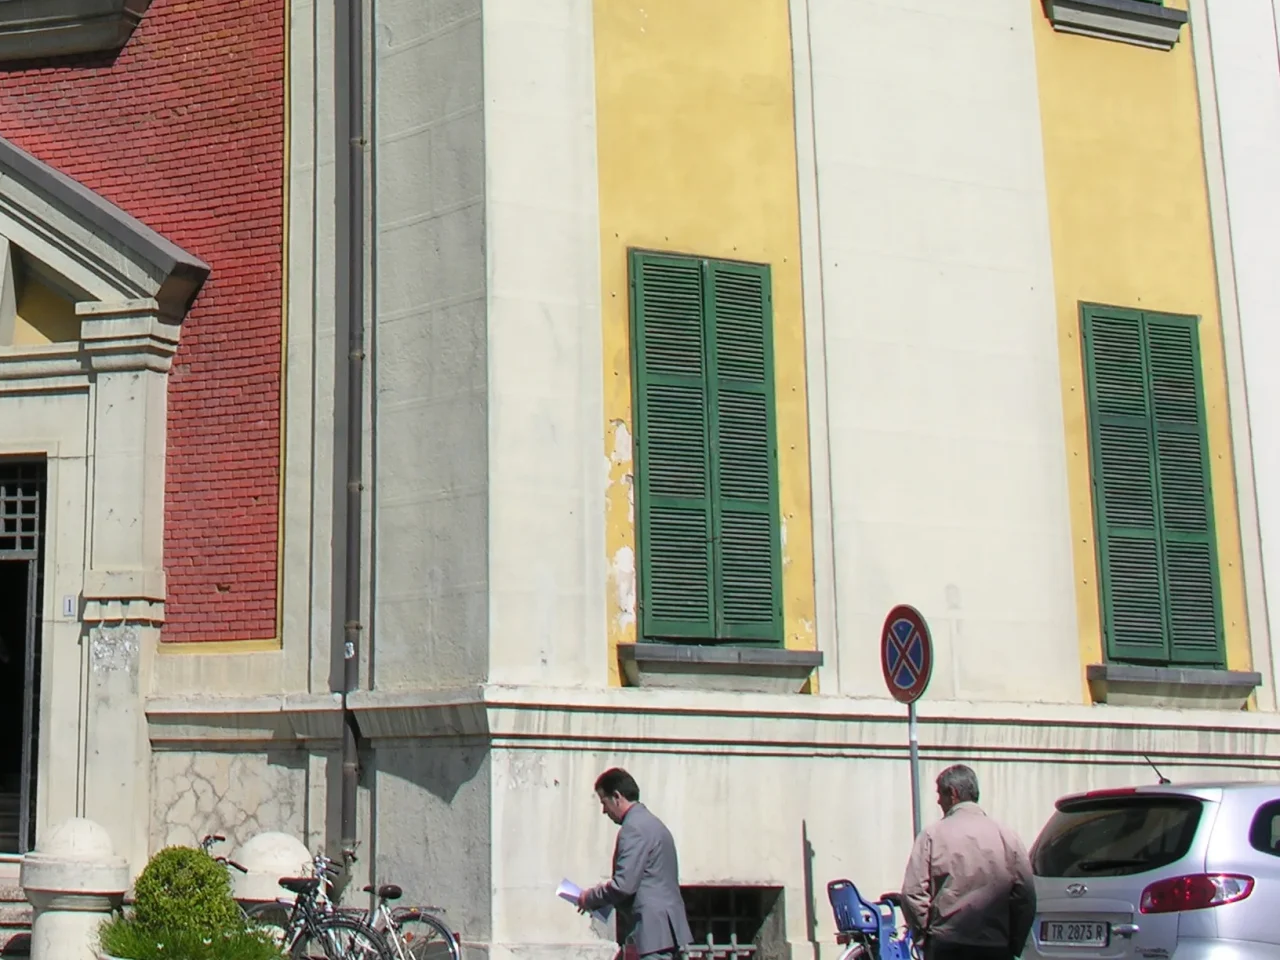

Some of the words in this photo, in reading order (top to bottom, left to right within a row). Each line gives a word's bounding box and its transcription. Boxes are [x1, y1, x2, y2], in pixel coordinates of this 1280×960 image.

[1051, 924, 1063, 940] TR
[1068, 924, 1093, 940] 2873
[1095, 925, 1104, 940] R
